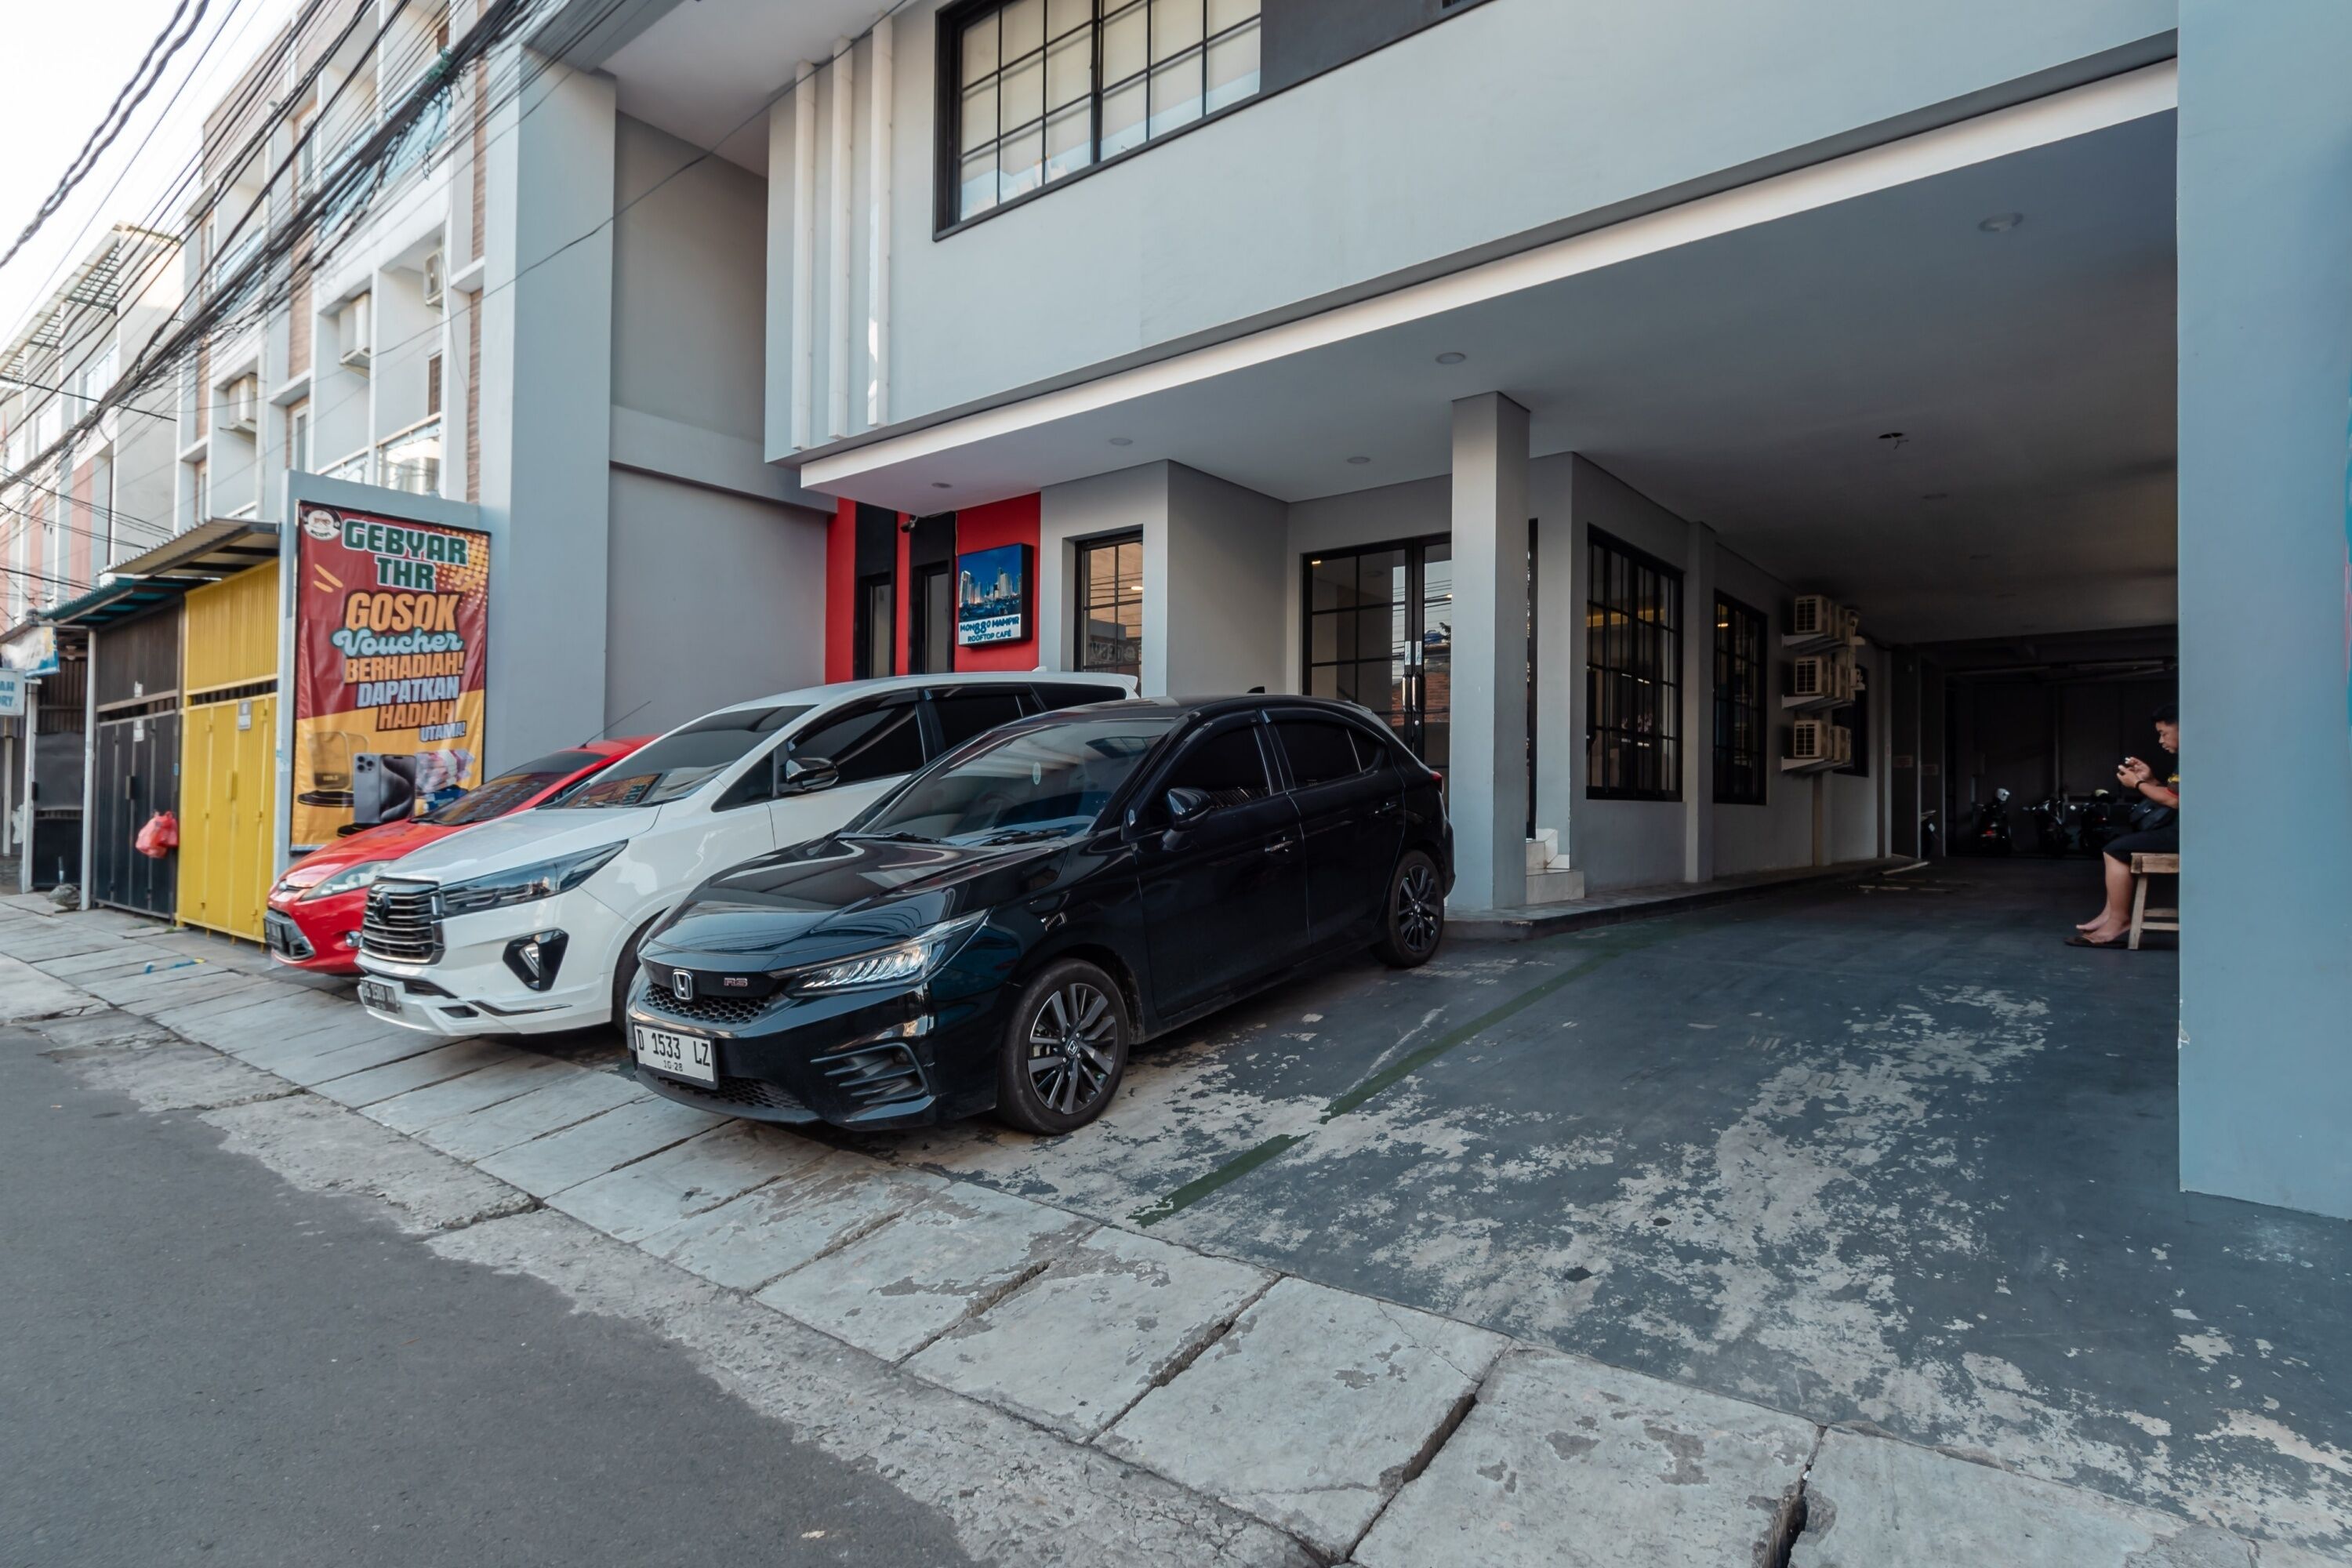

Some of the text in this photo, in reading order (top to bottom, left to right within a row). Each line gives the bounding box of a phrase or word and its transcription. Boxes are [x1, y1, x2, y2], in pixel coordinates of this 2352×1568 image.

[343, 520, 467, 566] GEBYAR
[375, 555, 436, 592] THR
[346, 593, 459, 632] GOSOK
[992, 616, 1020, 628] MAMPIR
[332, 628, 463, 656] Voucher
[967, 633, 995, 643] ROOFTOP
[345, 652, 465, 683] BERHADIAH!
[357, 676, 460, 708] DAPATKAN
[379, 701, 456, 730] HADIAH
[420, 721, 465, 742] UTAMA!
[724, 978, 748, 987] RS
[637, 1029, 710, 1067] D 1533 LZ
